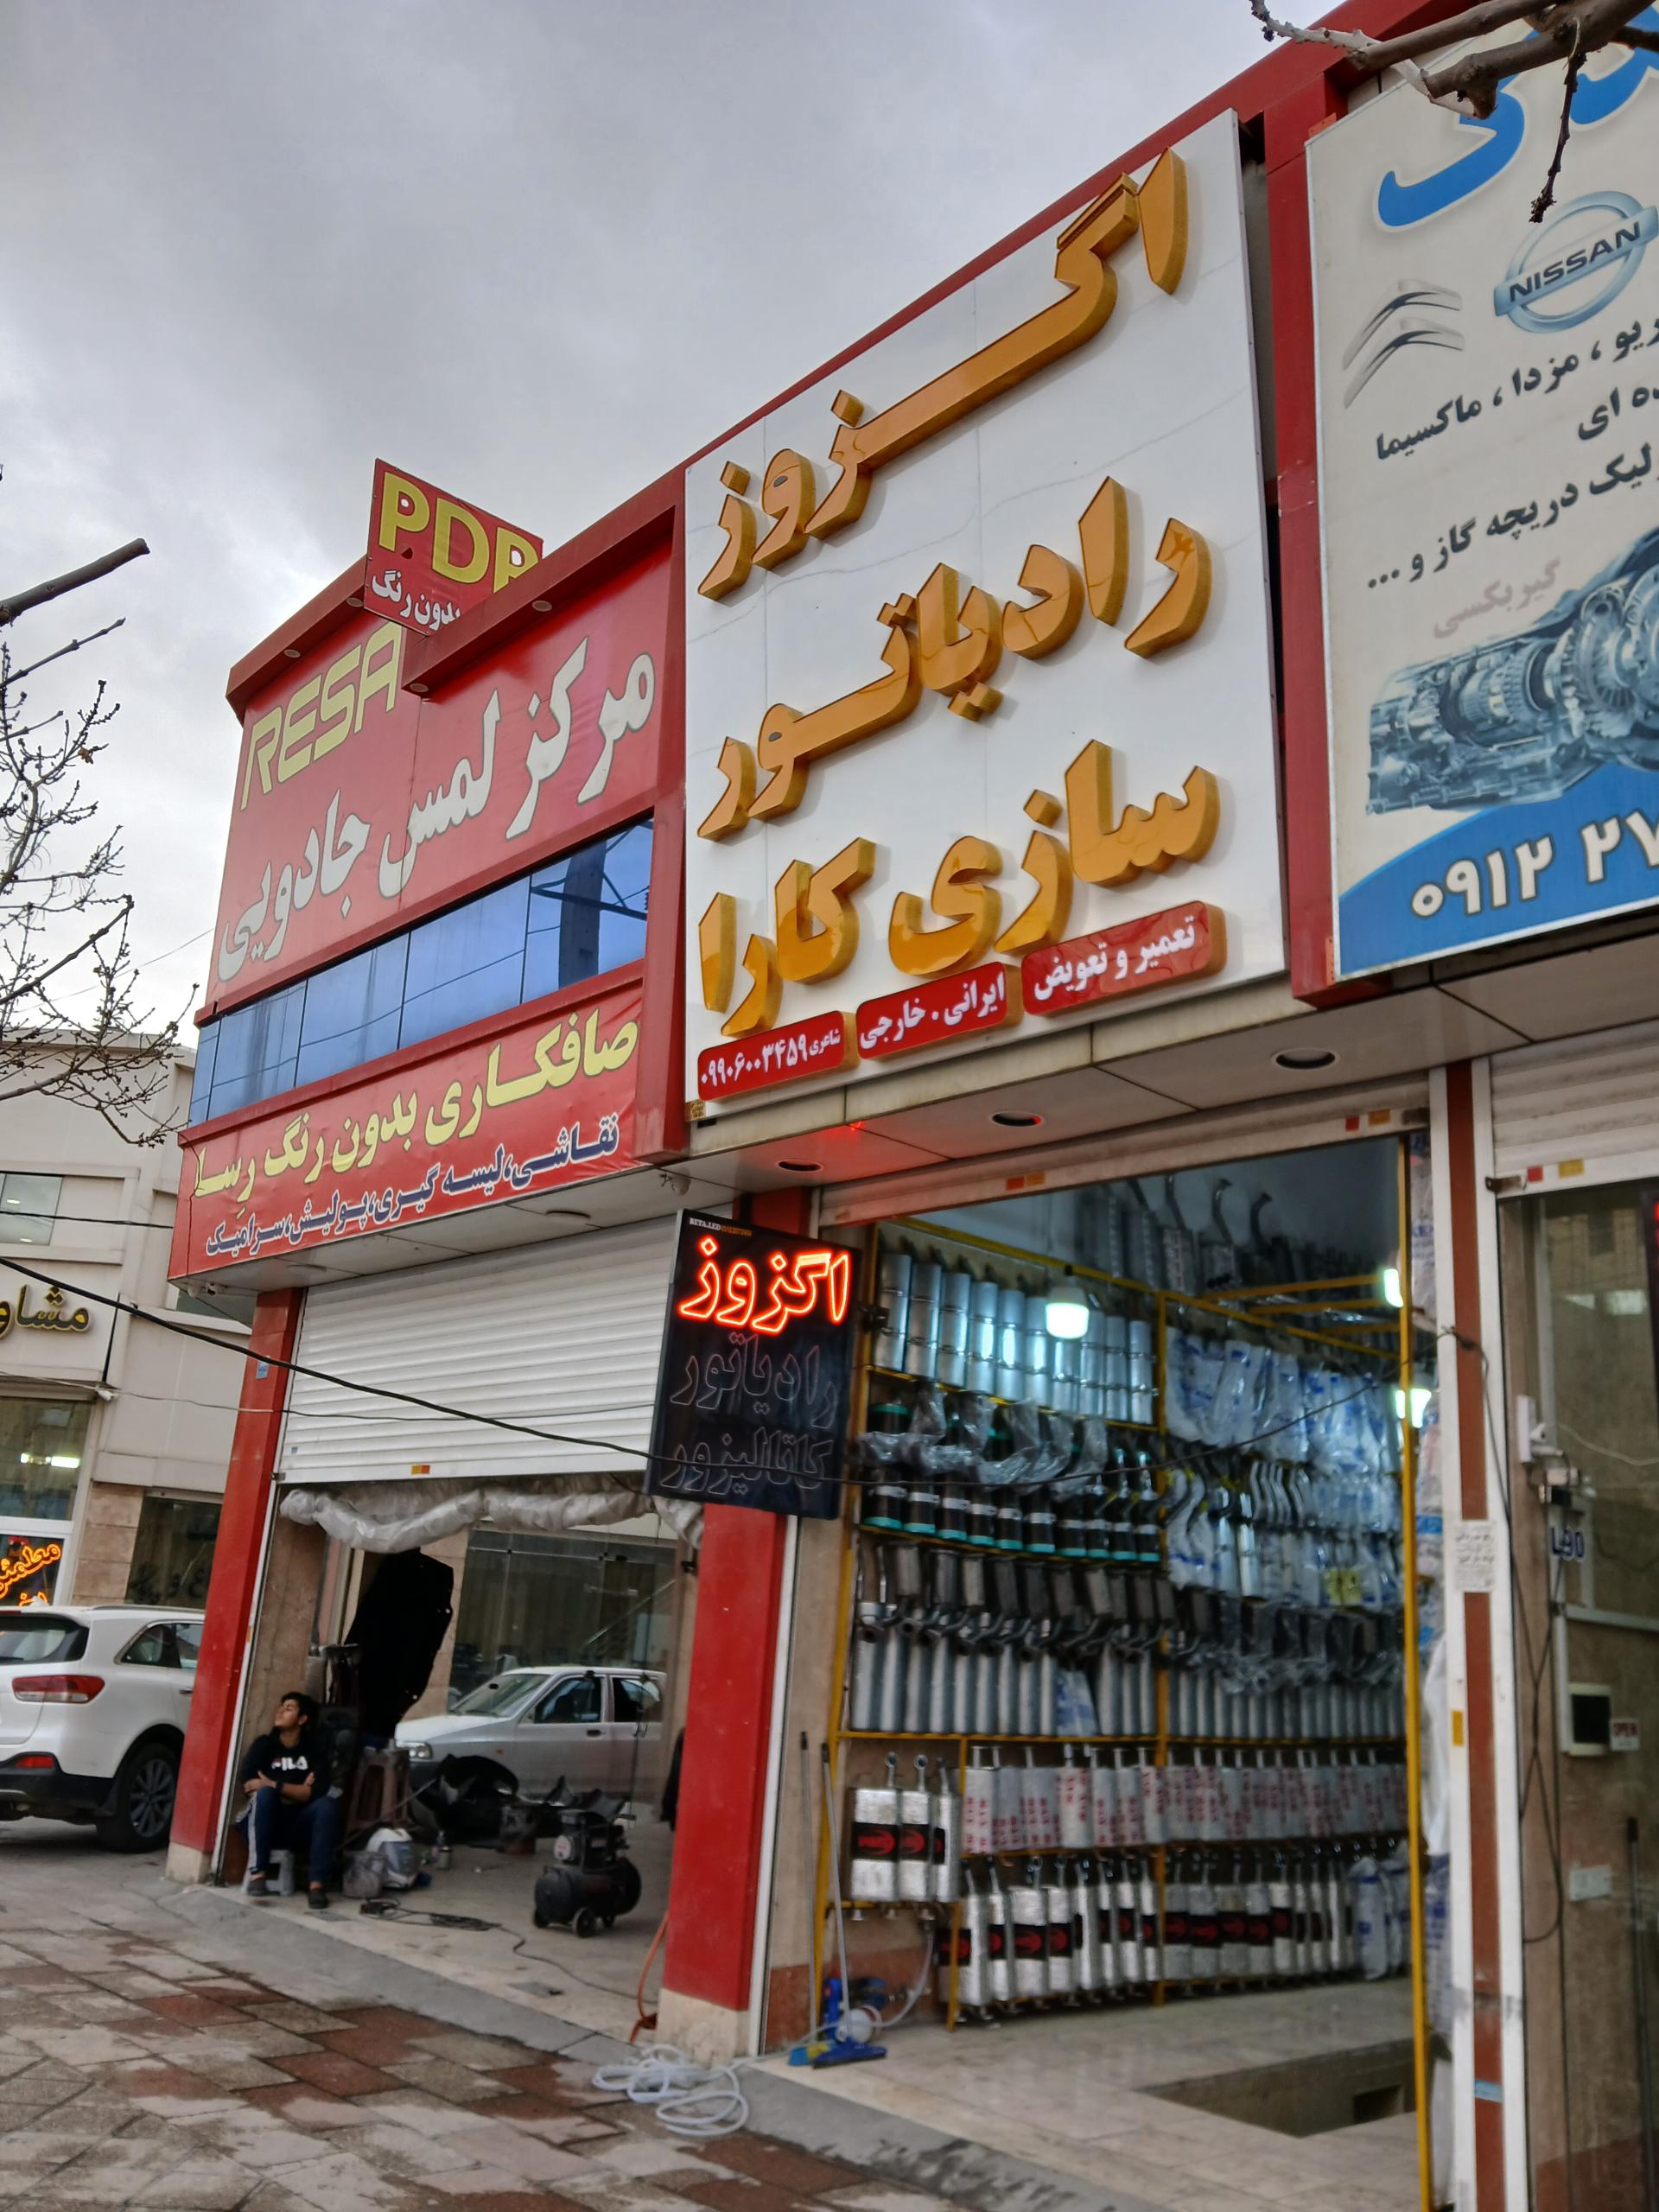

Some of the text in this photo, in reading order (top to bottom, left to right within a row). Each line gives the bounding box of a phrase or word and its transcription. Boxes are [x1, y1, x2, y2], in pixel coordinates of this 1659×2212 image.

[1510, 221, 1642, 301] NISSAN
[696, 146, 1189, 601] اگزوز
[1512, 354, 1579, 397] مزدا
[1377, 397, 1483, 461] ماکسیما
[1433, 517, 1476, 573] گاز
[1486, 482, 1579, 541] دریچه
[696, 476, 1212, 842] رادیاتور
[240, 622, 403, 811] RESA
[217, 635, 656, 983] مرکز لمس جادویی
[697, 739, 1221, 1038] سازی کارا
[944, 971, 1006, 1026] ایرانی
[1033, 916, 1196, 1001] تعمیر و تعویض
[701, 1033, 808, 1087] ۰۹۹۰۶۰۰۳۴۵۹
[860, 997, 926, 1050] خارجی
[424, 1008, 640, 1146] صافکاری
[264, 1112, 325, 1185] رنگ
[330, 1091, 418, 1174] بدون
[205, 1213, 286, 1258] سرامیک
[678, 1236, 849, 1333] اگزوز
[670, 1332, 839, 1429] رادیاتور
